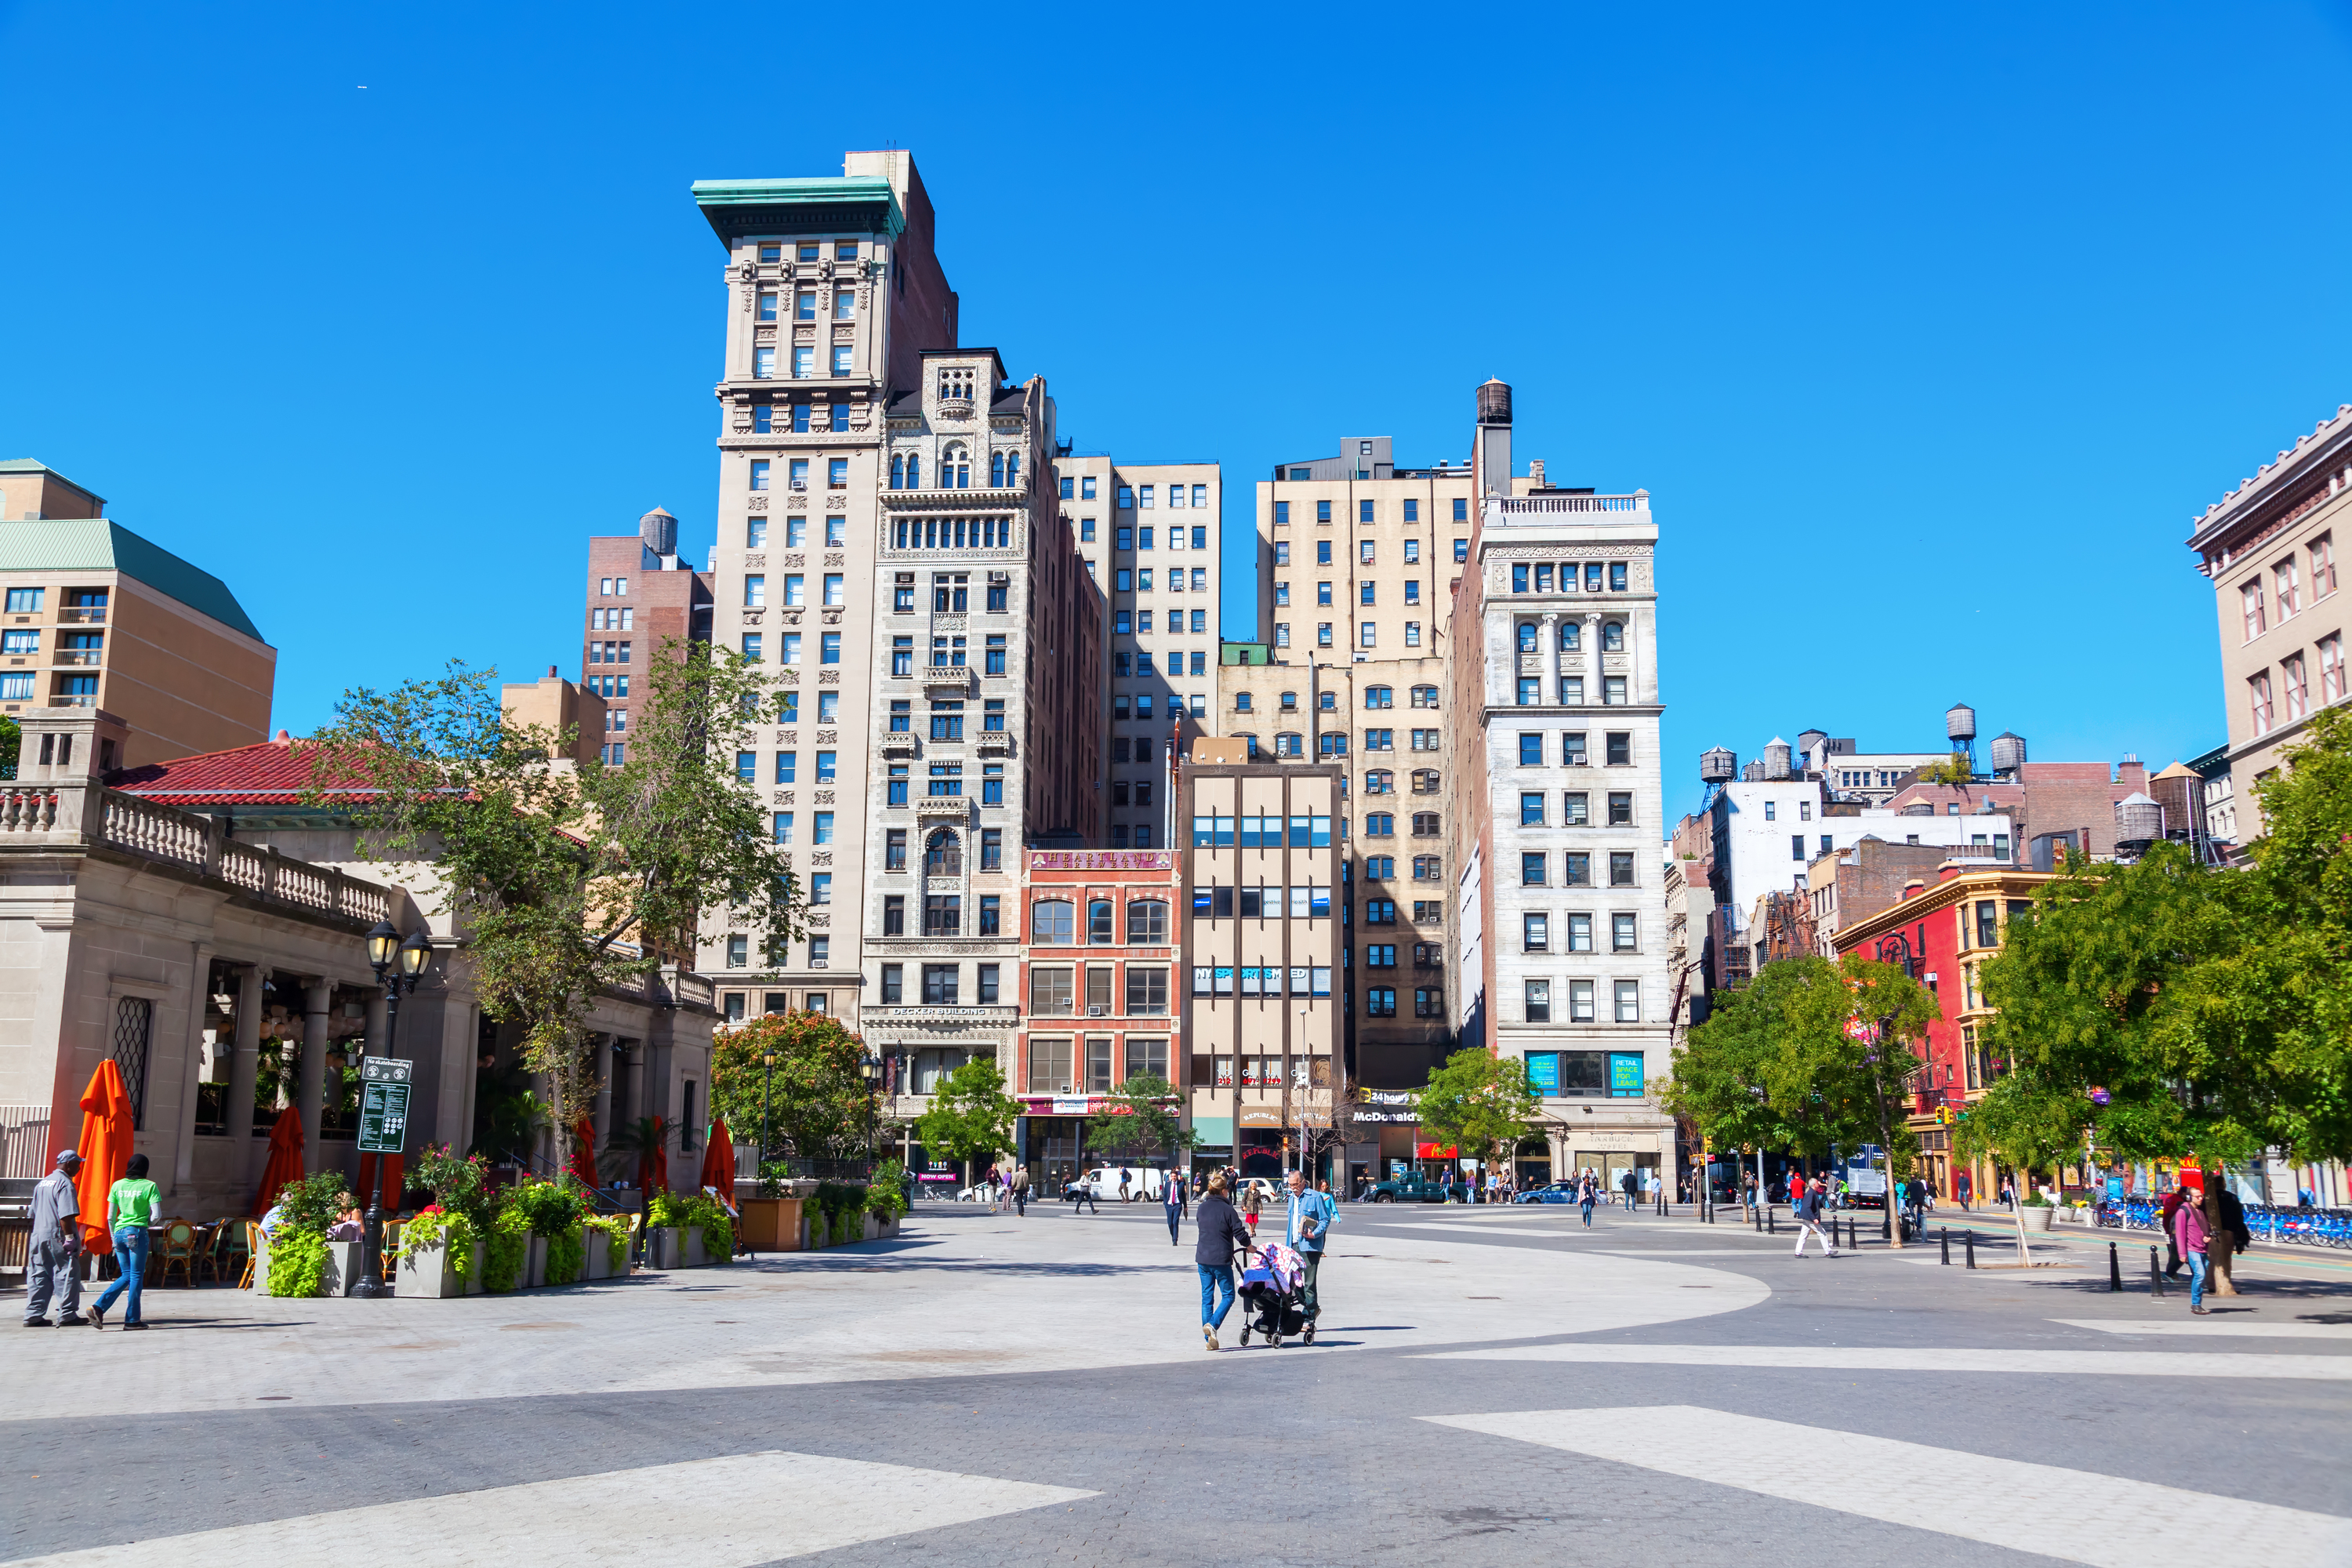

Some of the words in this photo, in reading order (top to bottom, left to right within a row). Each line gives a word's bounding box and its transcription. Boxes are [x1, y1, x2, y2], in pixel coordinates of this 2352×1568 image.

[1049, 853, 1154, 862] HEARTLAND
[375, 1059, 409, 1069] skateboarding
[1371, 1092, 1383, 1101] 24
[1243, 1112, 1278, 1121] REPUBLIC
[1353, 1112, 1424, 1122] McDonald's
[1242, 1147, 1281, 1160] REPUBLIC
